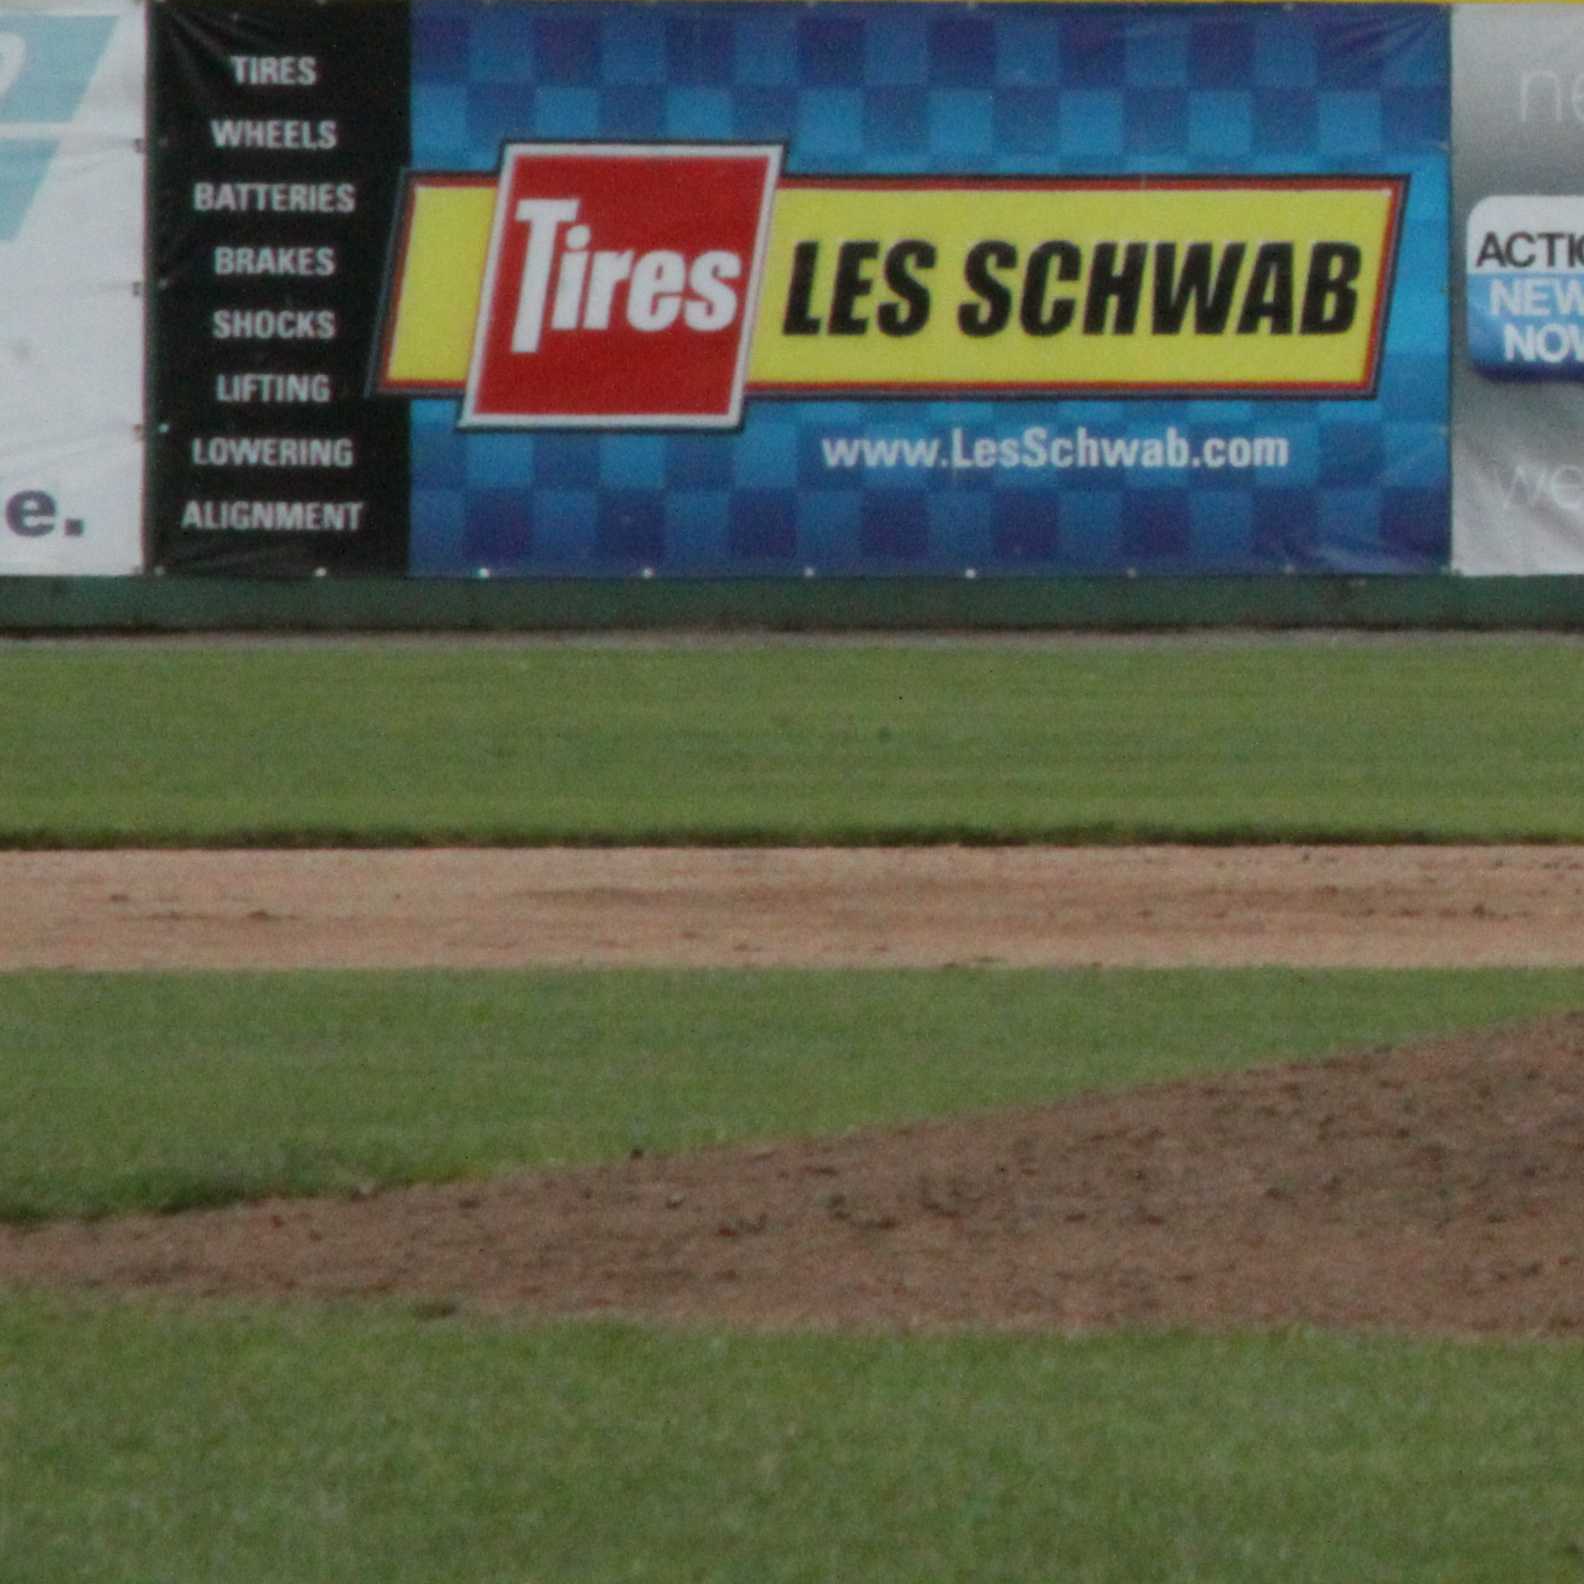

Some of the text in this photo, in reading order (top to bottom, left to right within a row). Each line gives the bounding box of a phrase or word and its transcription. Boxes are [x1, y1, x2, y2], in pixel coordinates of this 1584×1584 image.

[233, 56, 317, 85] TIRES
[211, 121, 338, 150] WHEELS
[193, 183, 356, 214] BATTERIES
[214, 247, 336, 277] BRAKES
[511, 198, 742, 354] Tires
[781, 239, 1364, 338] LES SCHWAB
[212, 310, 337, 341] SHOCKS
[216, 374, 331, 405] LIFTING
[192, 438, 355, 469] LOWERING
[821, 427, 1291, 470] www.LesSchwab.com
[180, 502, 364, 533] ALIGNMENT
